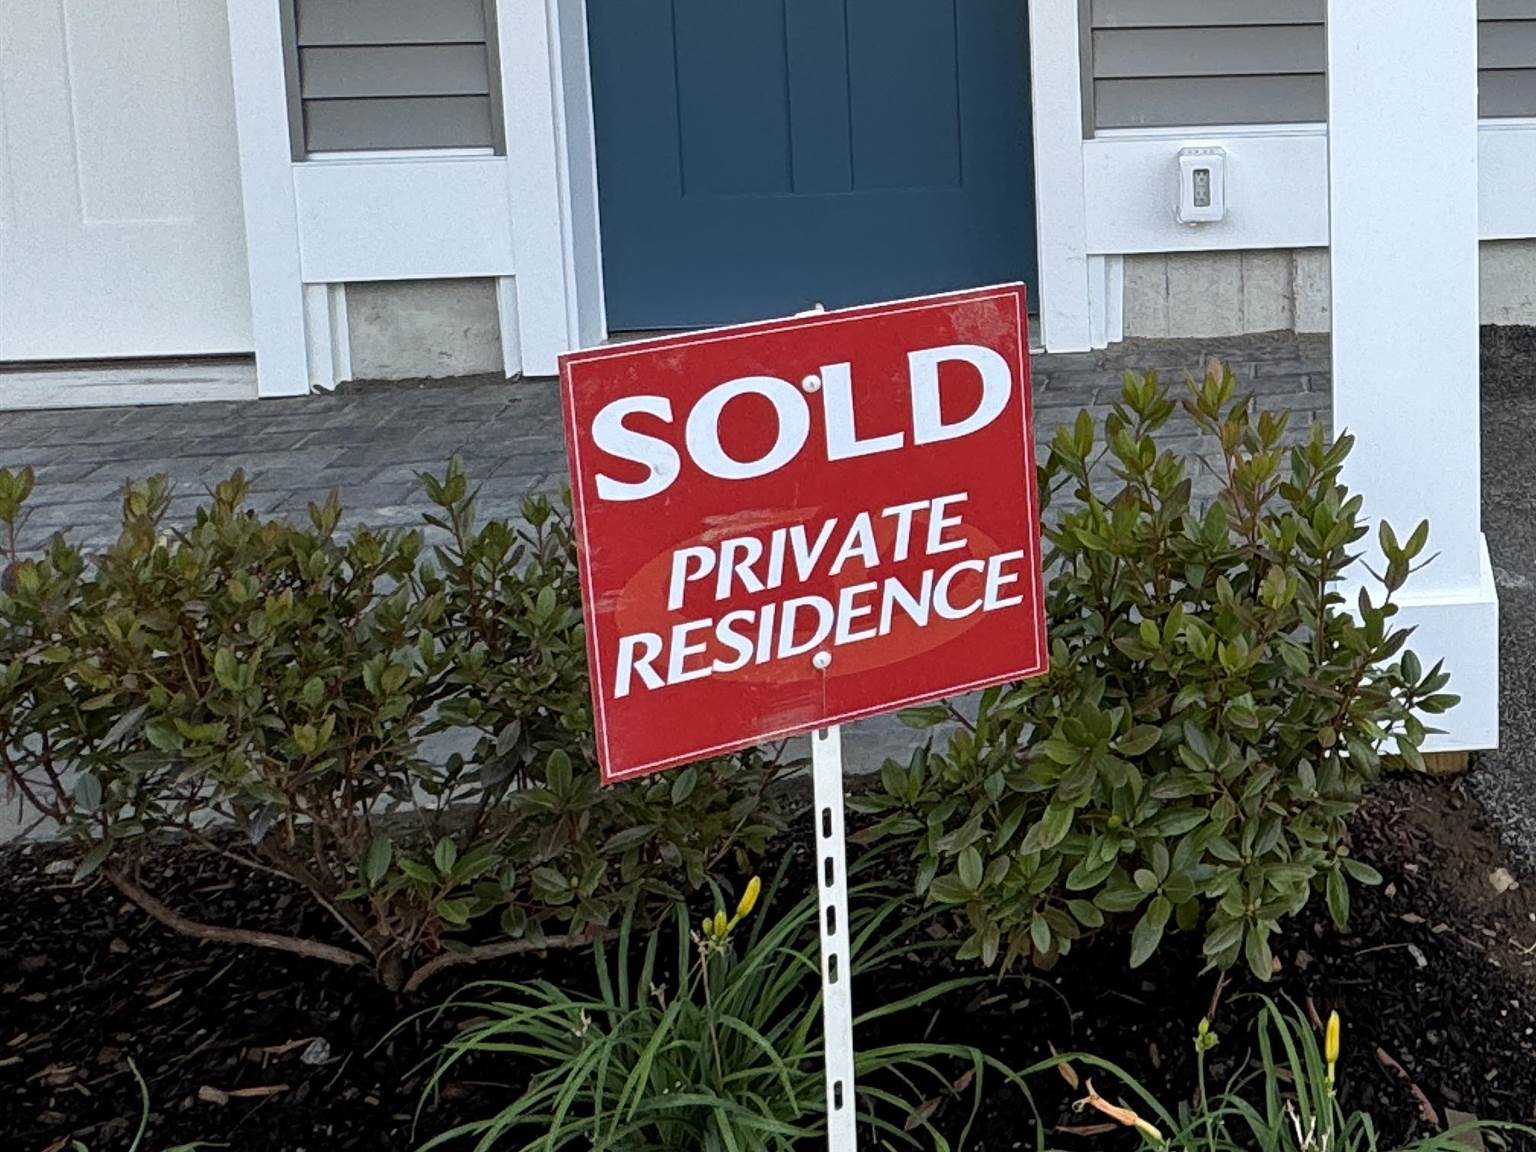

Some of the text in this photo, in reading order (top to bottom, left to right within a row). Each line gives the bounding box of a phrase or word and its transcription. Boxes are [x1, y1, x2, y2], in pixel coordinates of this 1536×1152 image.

[591, 344, 1012, 501] SOLD
[614, 550, 1024, 699] RESIDENCE
[667, 492, 968, 611] PRIVATE
